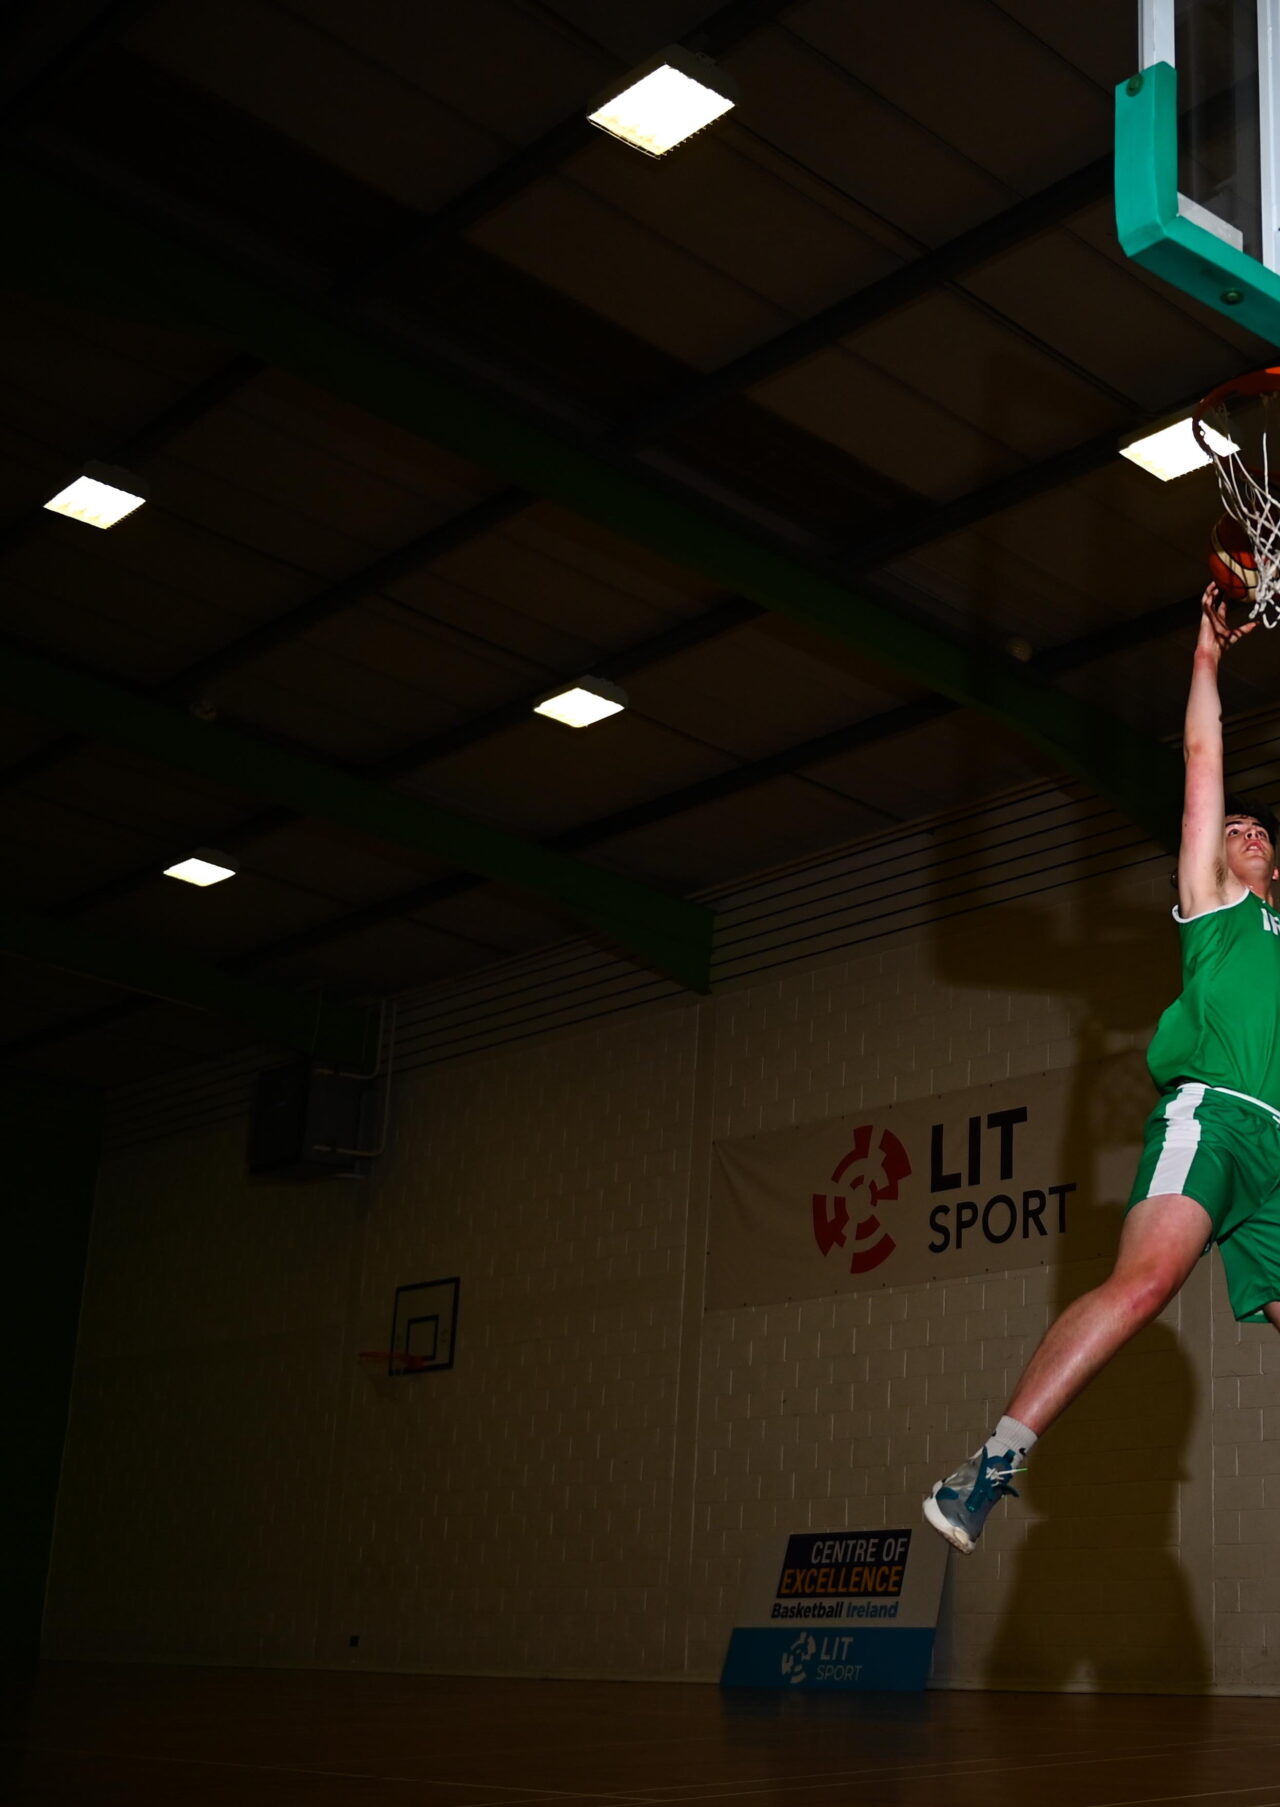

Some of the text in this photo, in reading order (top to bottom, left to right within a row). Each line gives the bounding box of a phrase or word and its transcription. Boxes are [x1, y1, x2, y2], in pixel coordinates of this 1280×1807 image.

[930, 1106, 1028, 1193] LIT
[928, 1182, 1077, 1254] SPORT
[811, 1537, 908, 1564] CENTRE OF
[780, 1565, 902, 1594] EXCELLENCE
[771, 1601, 898, 1619] Basketball Ireland
[820, 1636, 854, 1661] LIT
[815, 1664, 863, 1681] SPORT
